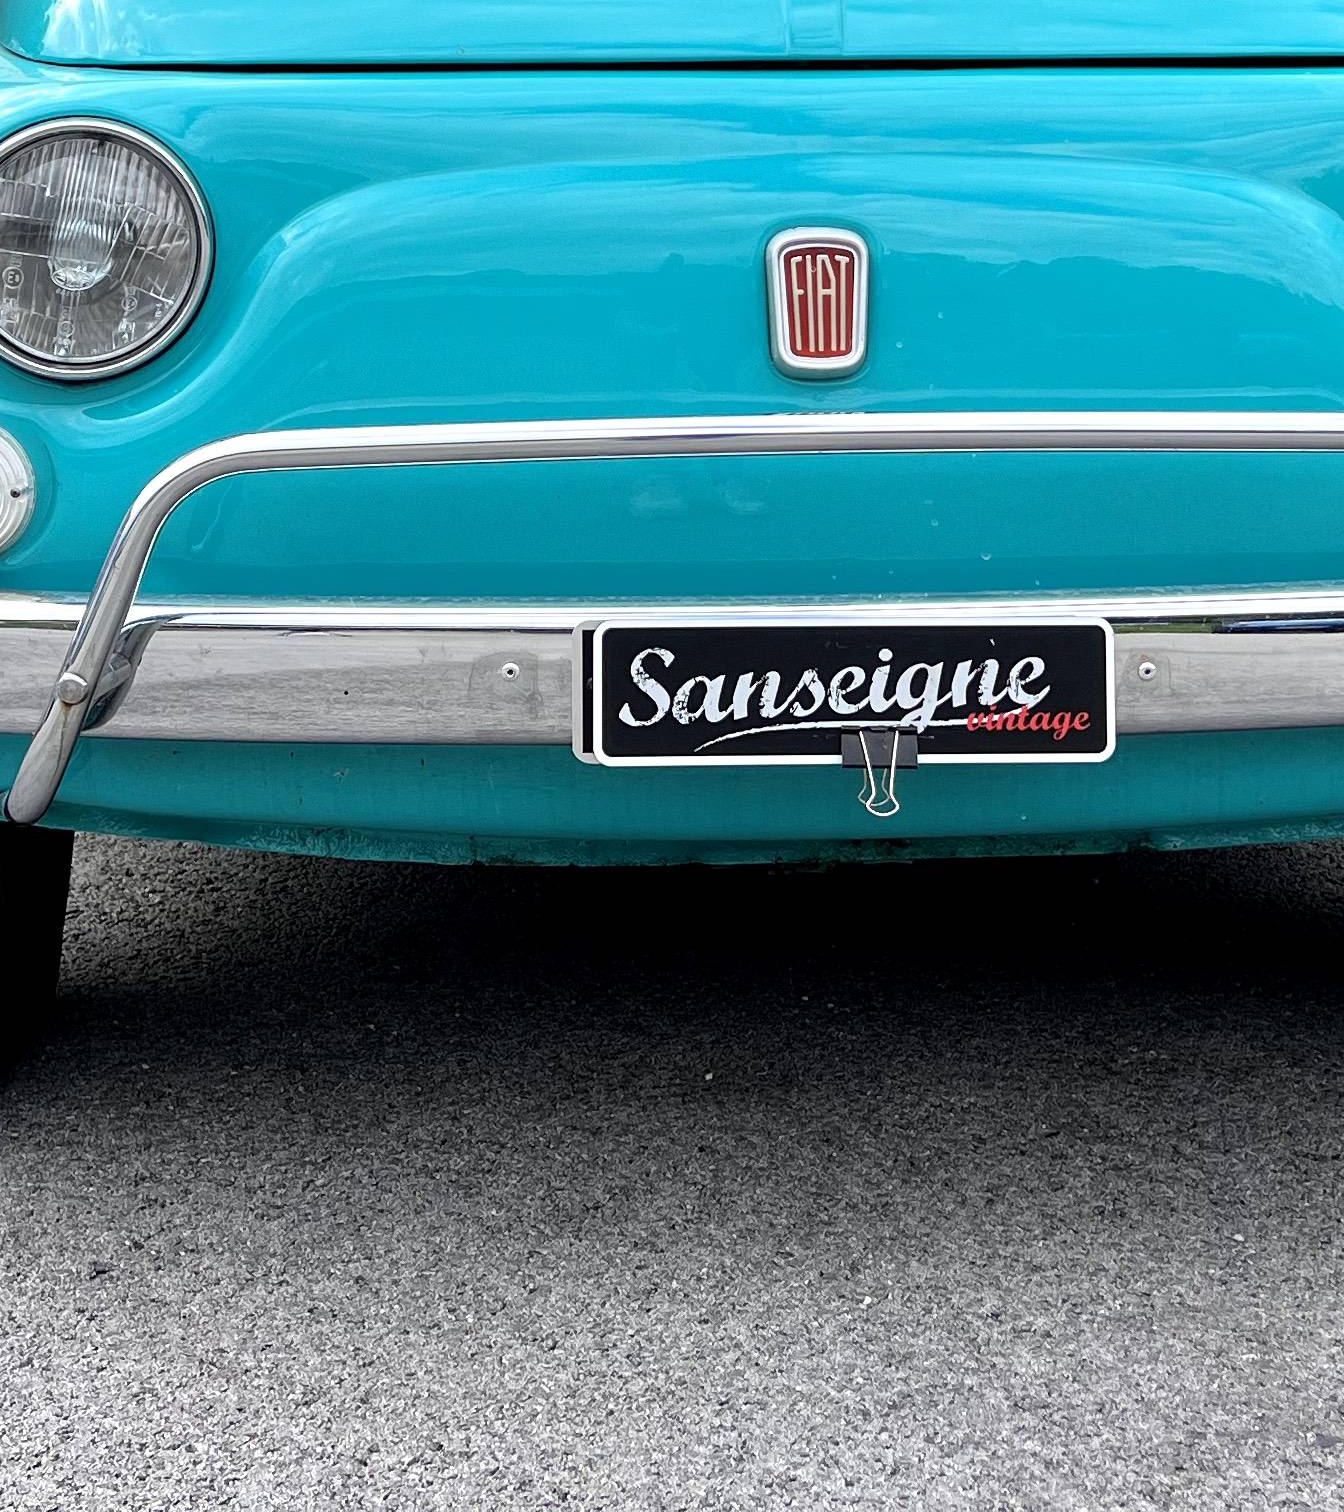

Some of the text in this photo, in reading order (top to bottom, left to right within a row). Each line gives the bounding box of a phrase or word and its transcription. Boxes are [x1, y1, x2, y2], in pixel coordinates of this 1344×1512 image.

[790, 254, 850, 353] FIAT
[618, 648, 1051, 736] Sanseigne
[966, 705, 1092, 740] vintage
